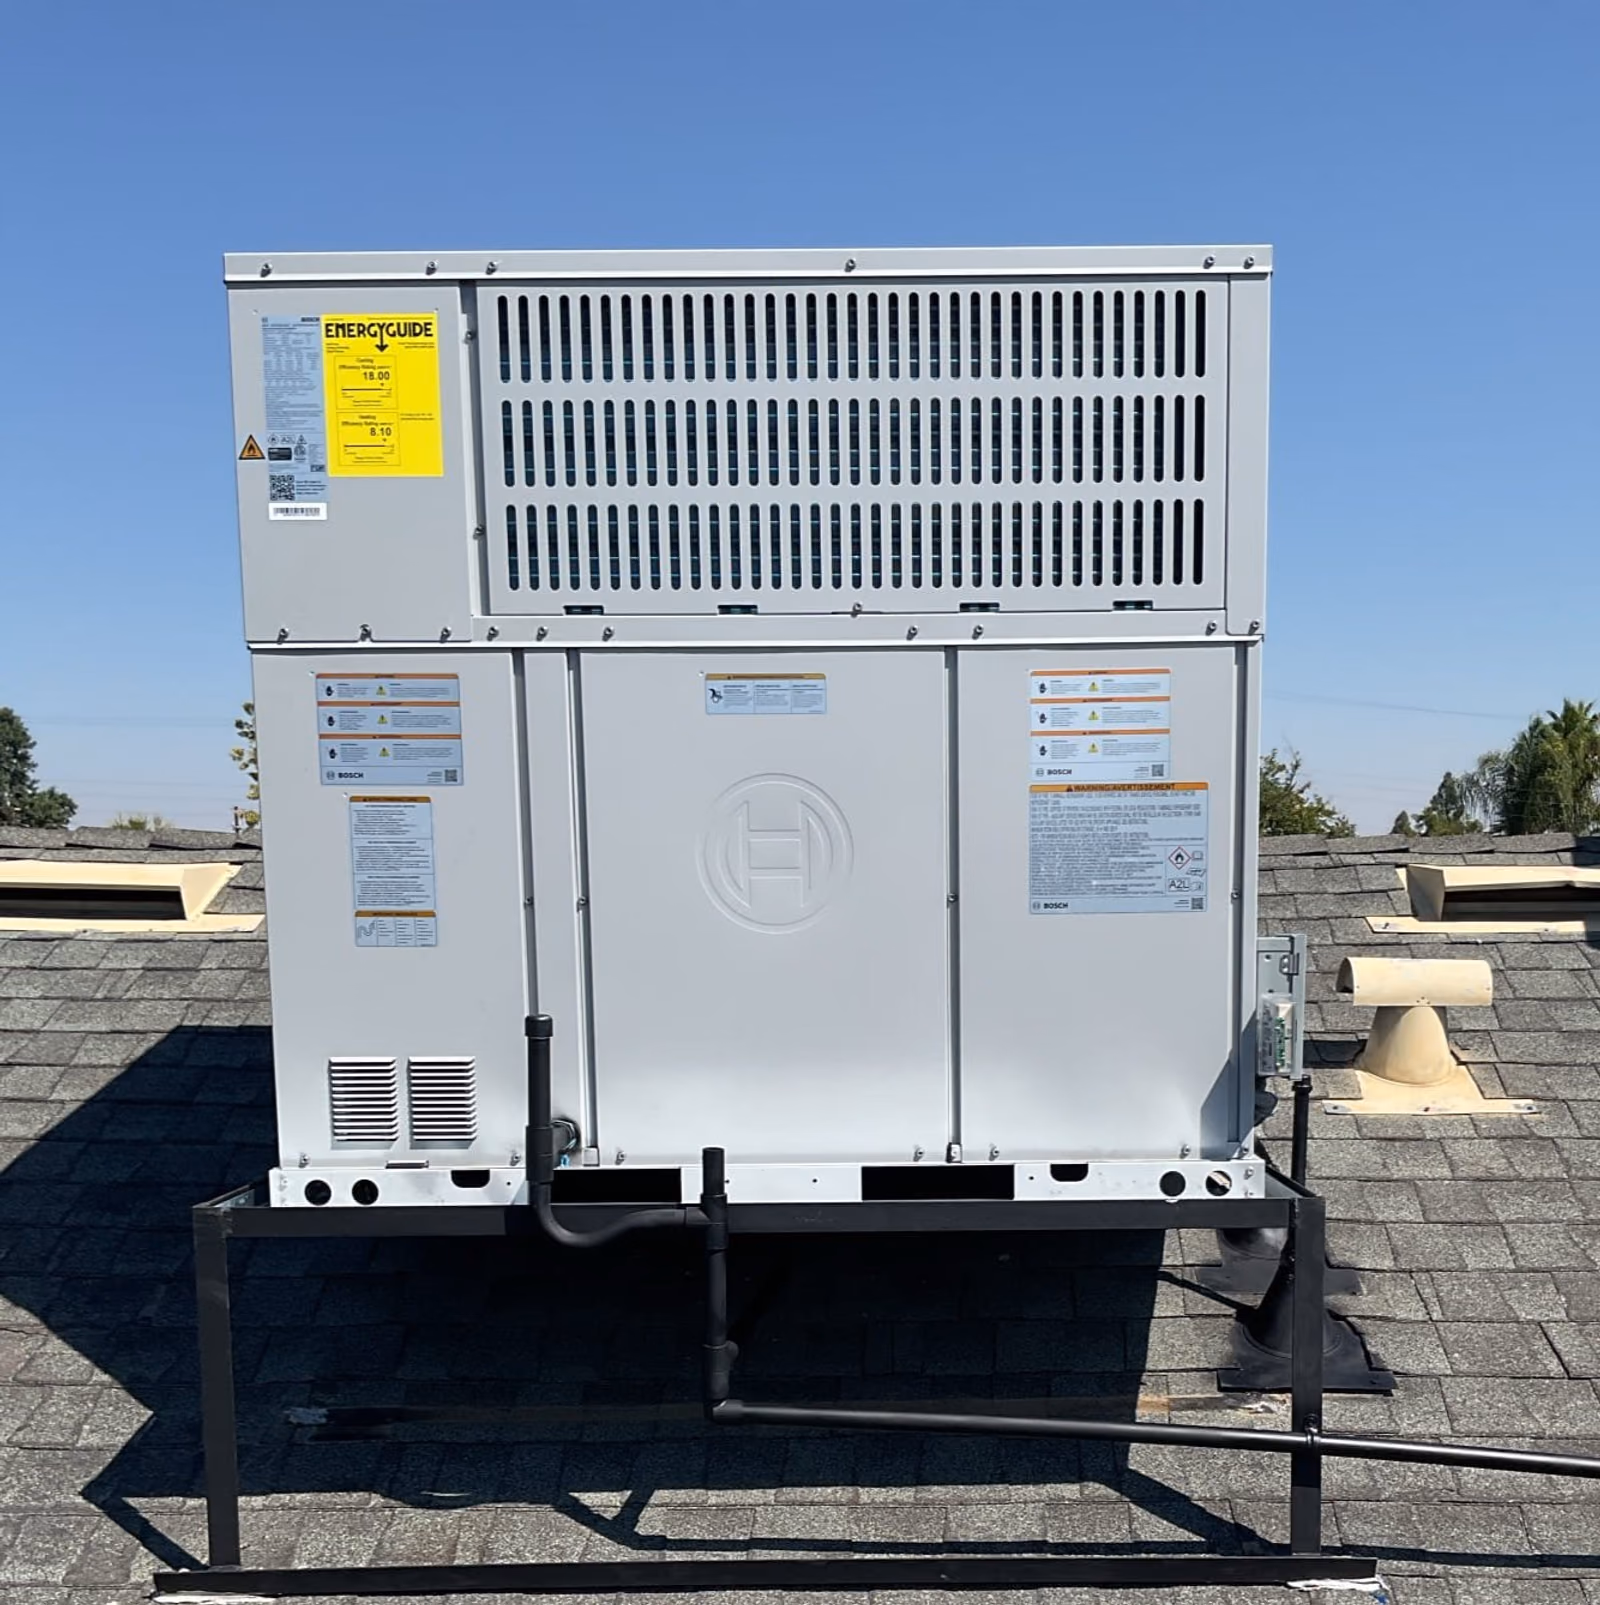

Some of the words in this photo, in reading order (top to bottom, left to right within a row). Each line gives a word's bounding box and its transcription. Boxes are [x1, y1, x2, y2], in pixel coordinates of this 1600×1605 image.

[325, 322, 434, 338] ENERGYGUIDE
[363, 371, 390, 381] 18.00
[370, 427, 392, 437] 8.10
[1169, 878, 1189, 890] A2L
